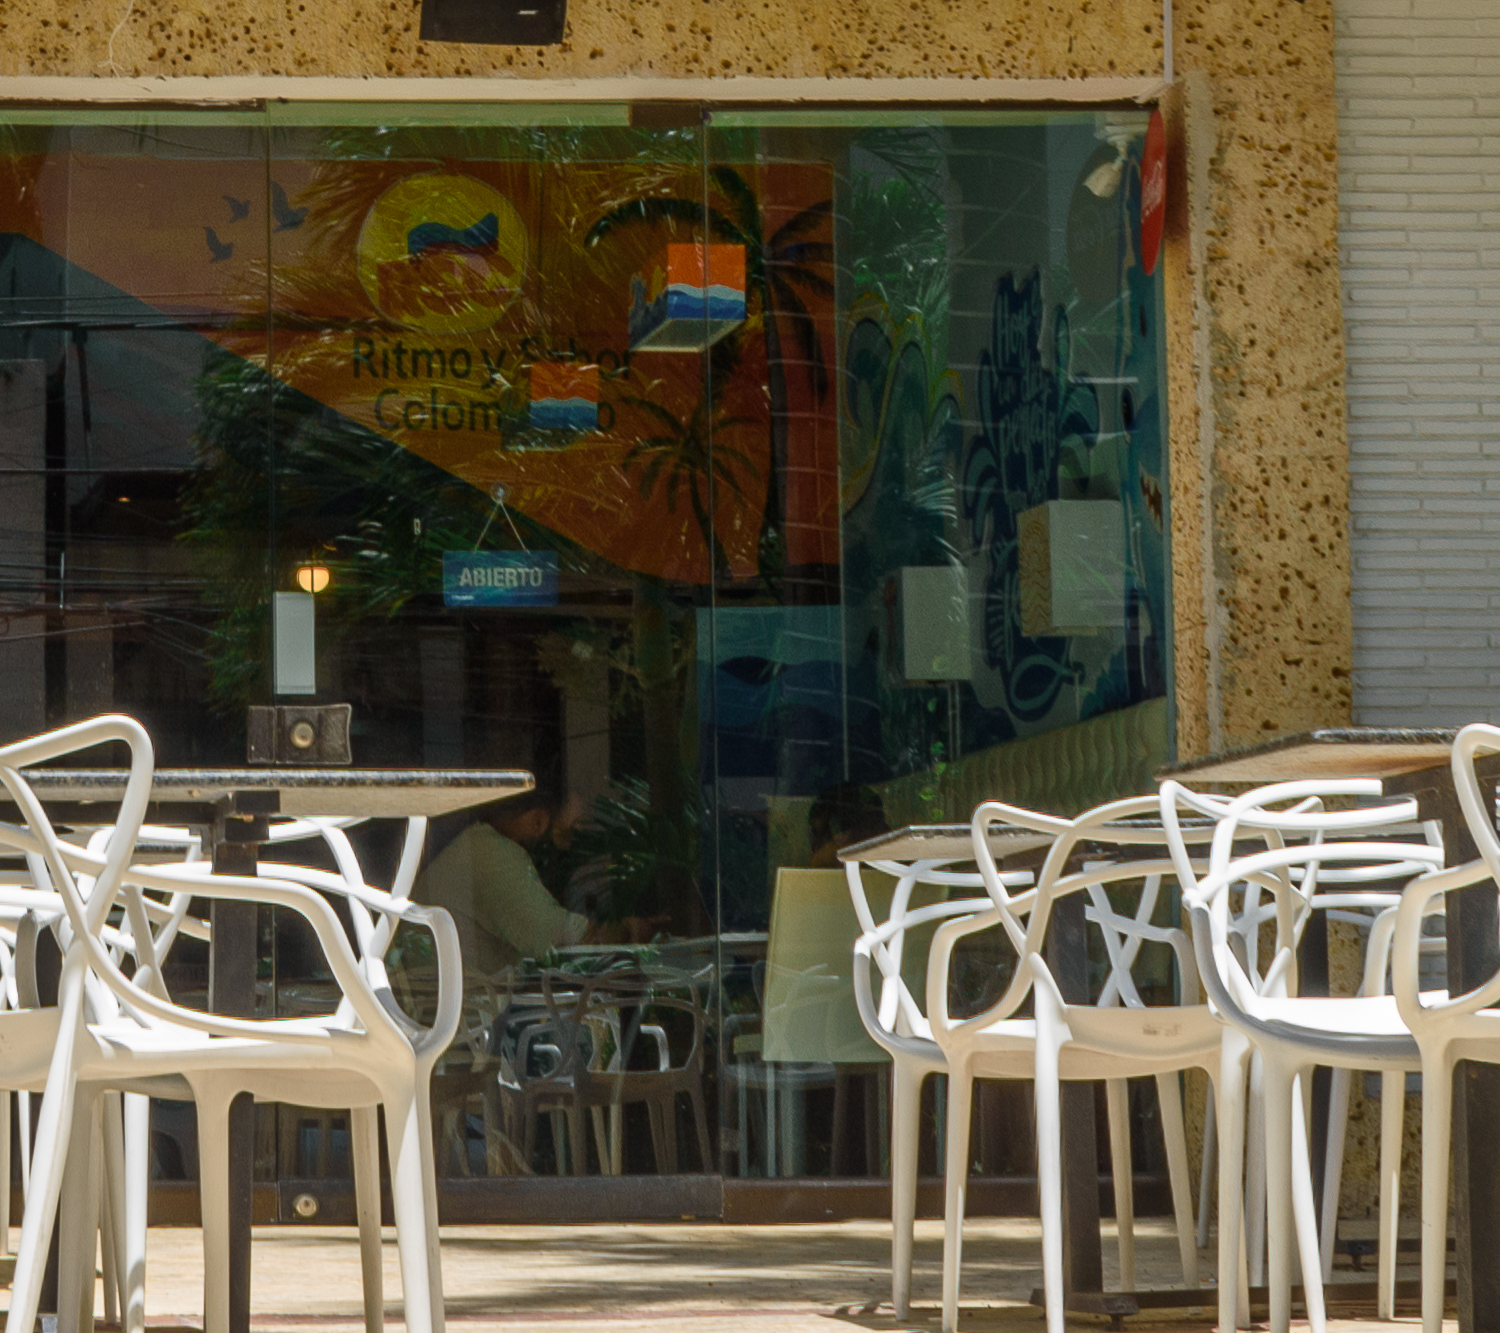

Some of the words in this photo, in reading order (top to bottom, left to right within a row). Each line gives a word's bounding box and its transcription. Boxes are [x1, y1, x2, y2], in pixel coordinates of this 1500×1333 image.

[353, 336, 472, 379] Ritmo
[481, 348, 507, 388] y
[459, 566, 543, 587] ABIERTO
